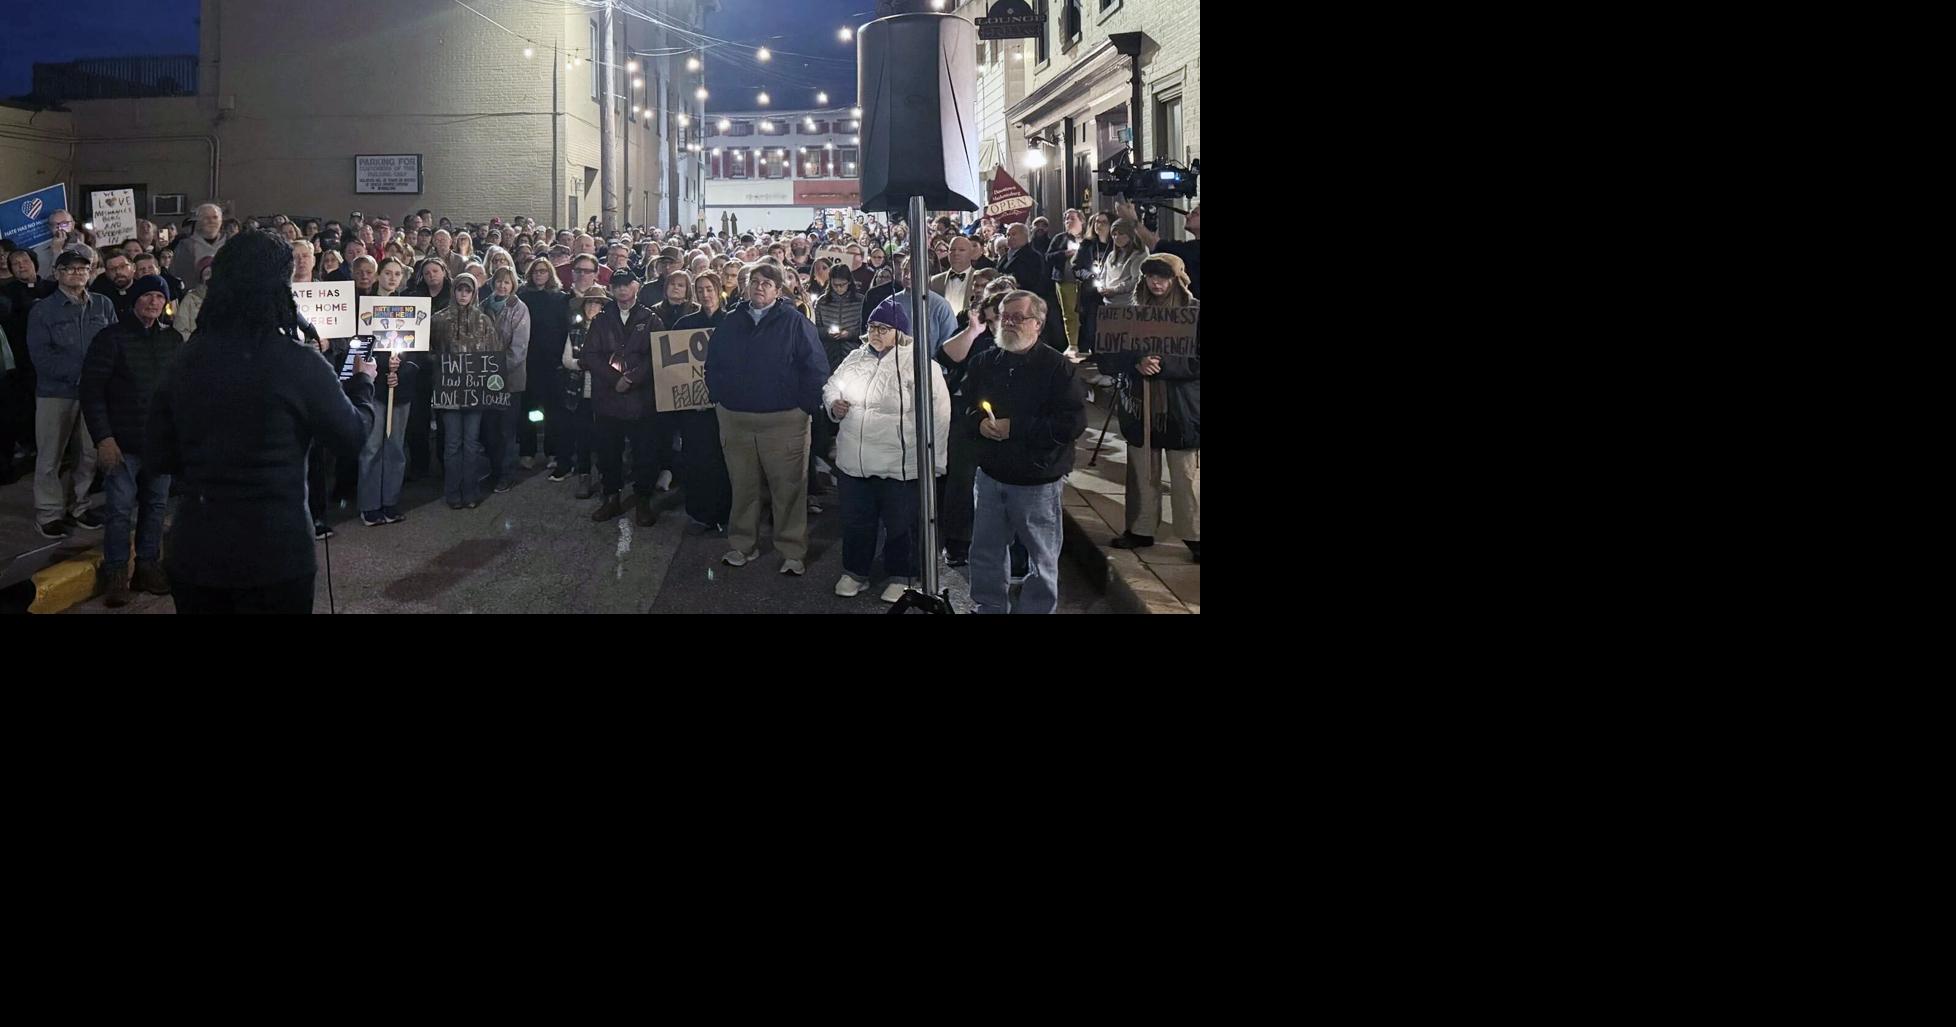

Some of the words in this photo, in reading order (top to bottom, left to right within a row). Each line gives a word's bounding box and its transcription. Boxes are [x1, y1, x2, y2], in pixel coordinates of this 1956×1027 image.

[359, 158, 395, 166] PARKING
[990, 197, 1028, 214] OPEN
[4, 228, 17, 237] HATE
[104, 222, 122, 230] AND
[292, 289, 313, 298] ATE
[318, 289, 341, 298] HAS
[315, 303, 348, 312] HOME
[307, 316, 338, 325] ERE!
[1122, 306, 1133, 319] IS
[1135, 306, 1196, 324] WEAKNESS
[1096, 332, 1129, 352] LOVE
[1130, 337, 1140, 352] IS
[441, 353, 475, 374] HATE
[481, 355, 499, 373] IS
[691, 365, 704, 379] N
[433, 389, 459, 406] LOVE
[461, 389, 479, 407] IS
[672, 379, 712, 410] HA
